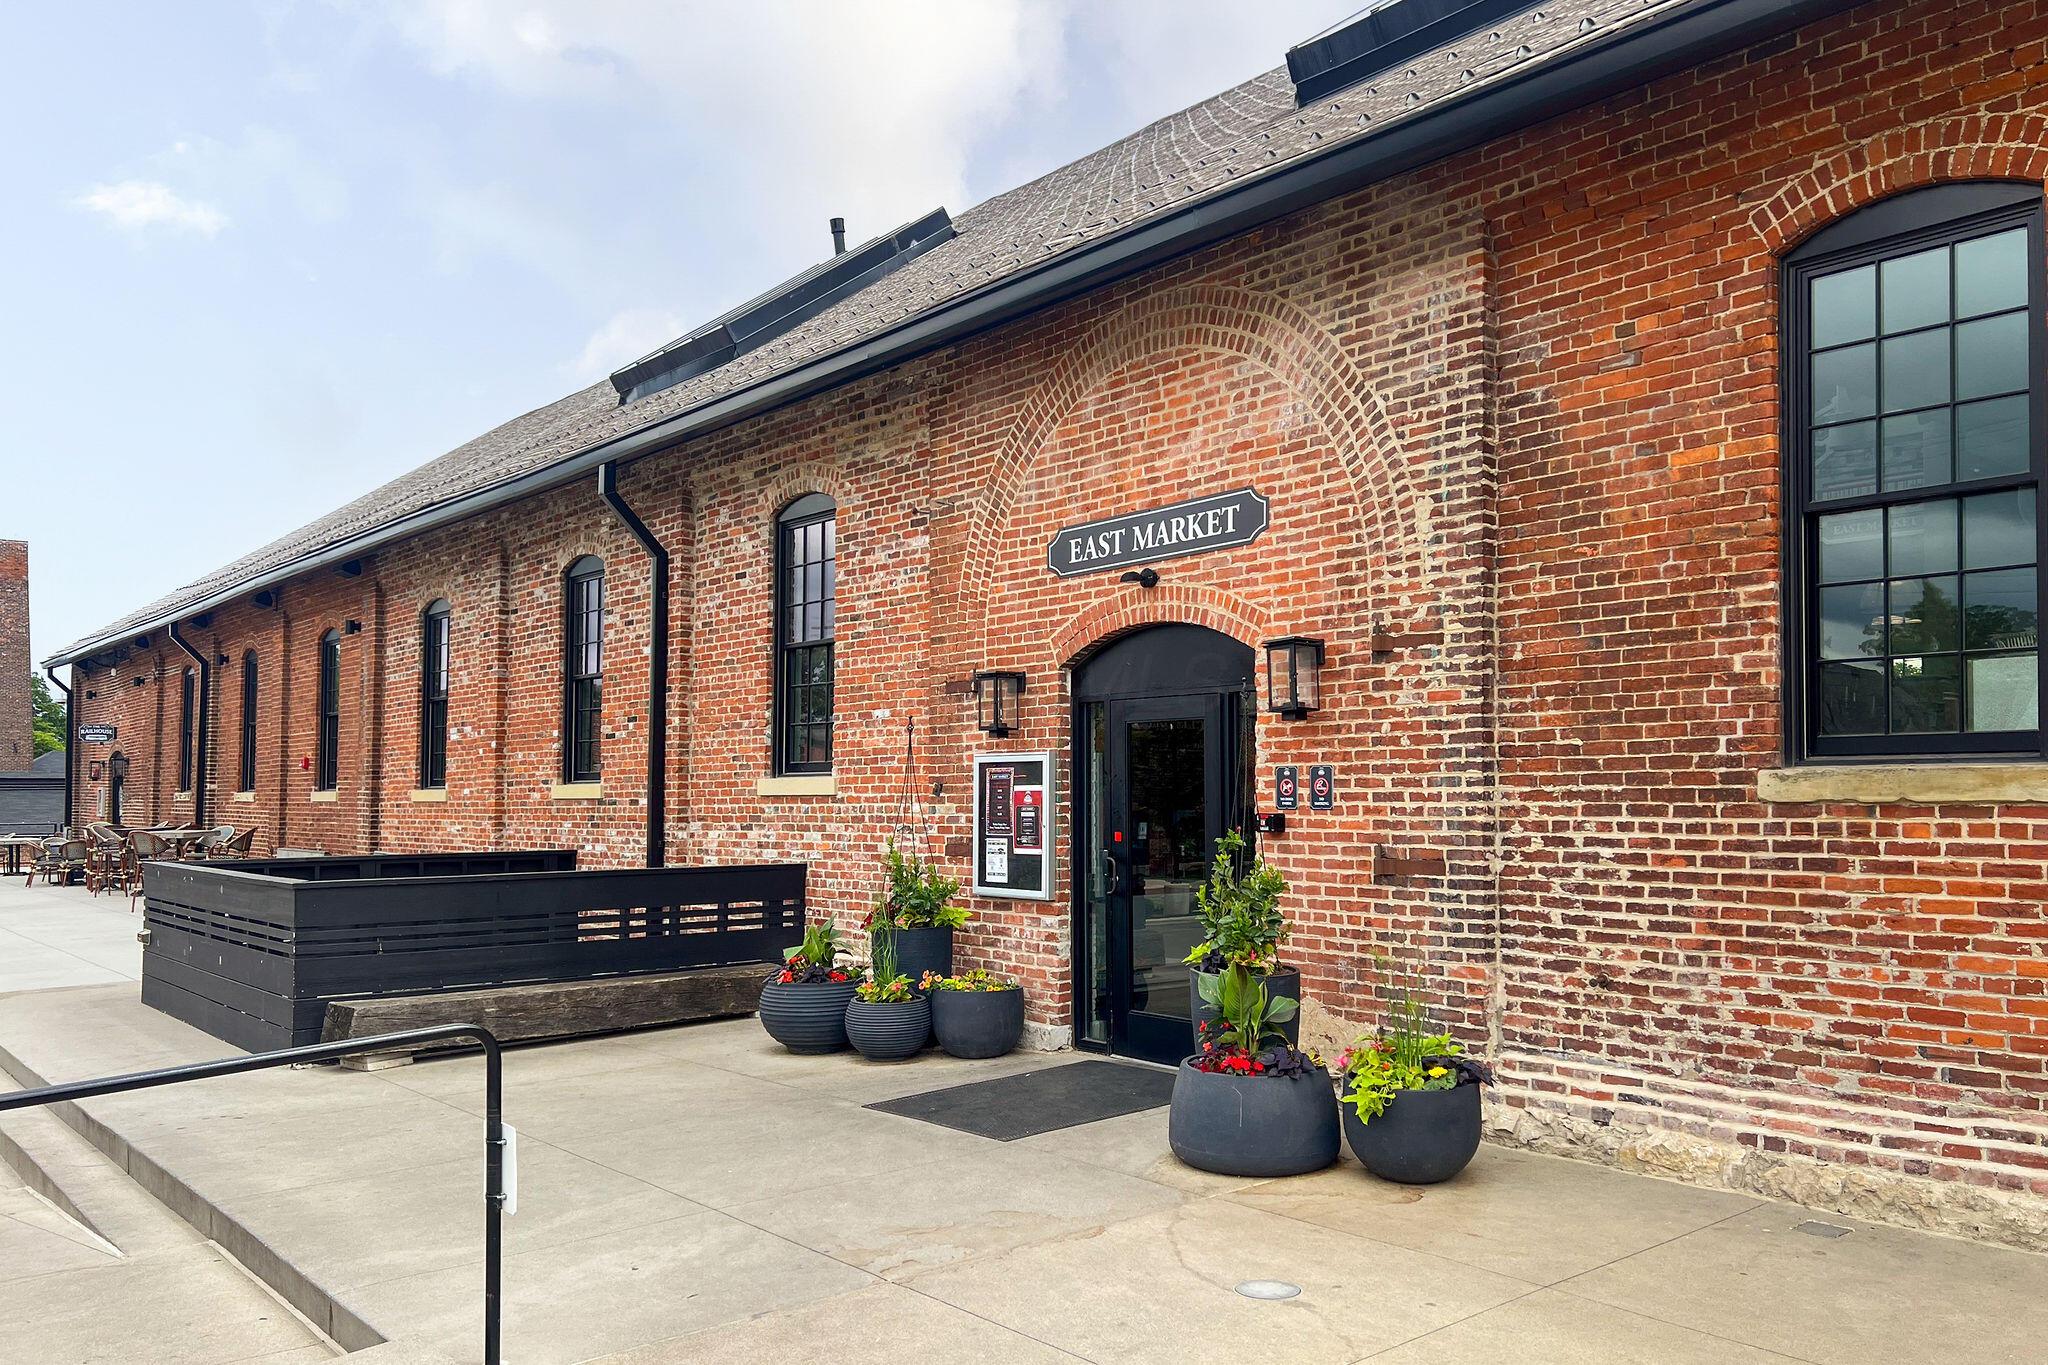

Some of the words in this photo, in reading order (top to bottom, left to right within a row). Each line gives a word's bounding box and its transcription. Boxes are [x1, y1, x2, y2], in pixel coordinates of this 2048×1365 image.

[1068, 527, 1126, 564] EAST
[1131, 503, 1241, 552] MARKET
[1864, 515, 1920, 533] MKET
